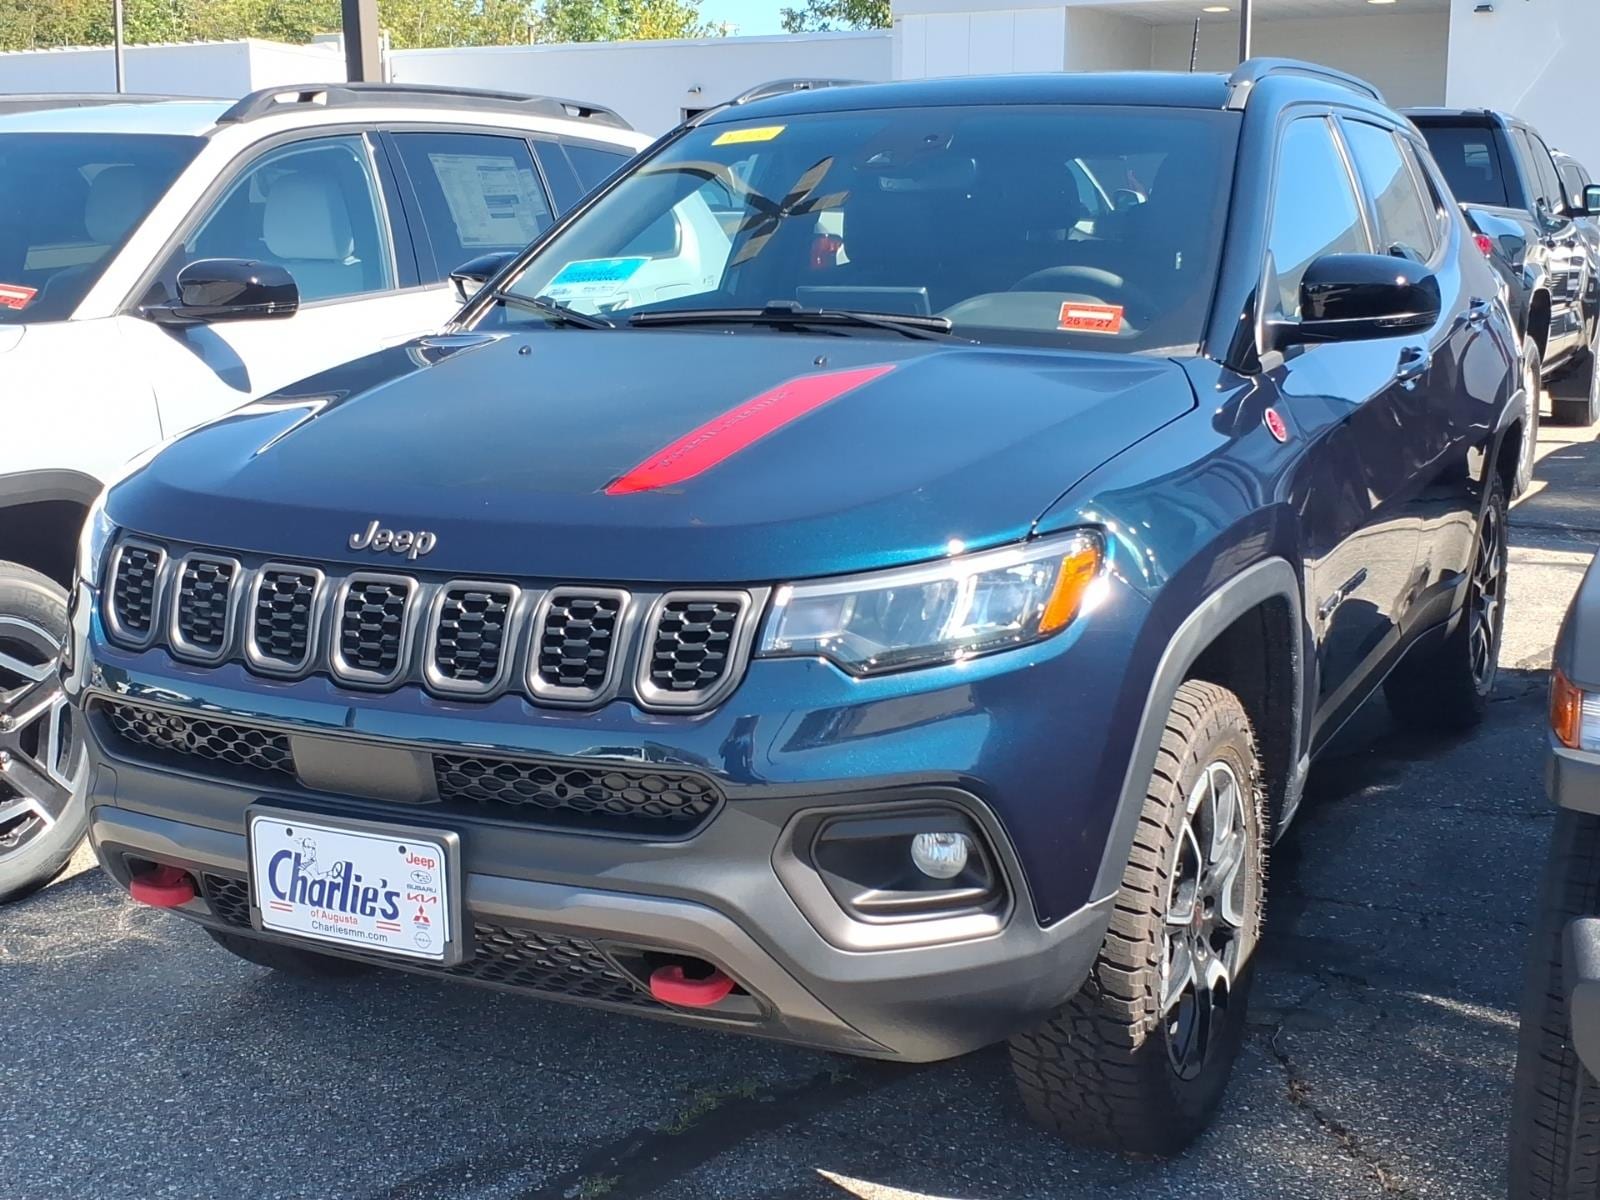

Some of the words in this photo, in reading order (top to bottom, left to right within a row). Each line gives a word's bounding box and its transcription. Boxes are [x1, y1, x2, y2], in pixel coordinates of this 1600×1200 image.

[1096, 319, 1112, 328] 27
[348, 520, 437, 560] Jeep
[406, 852, 436, 870] Jeep
[268, 849, 401, 921] Charlie's
[406, 883, 437, 894] SUBARU
[310, 909, 322, 919] of
[322, 911, 358, 925] Augusta
[311, 920, 388, 942] Charliesmm.com
